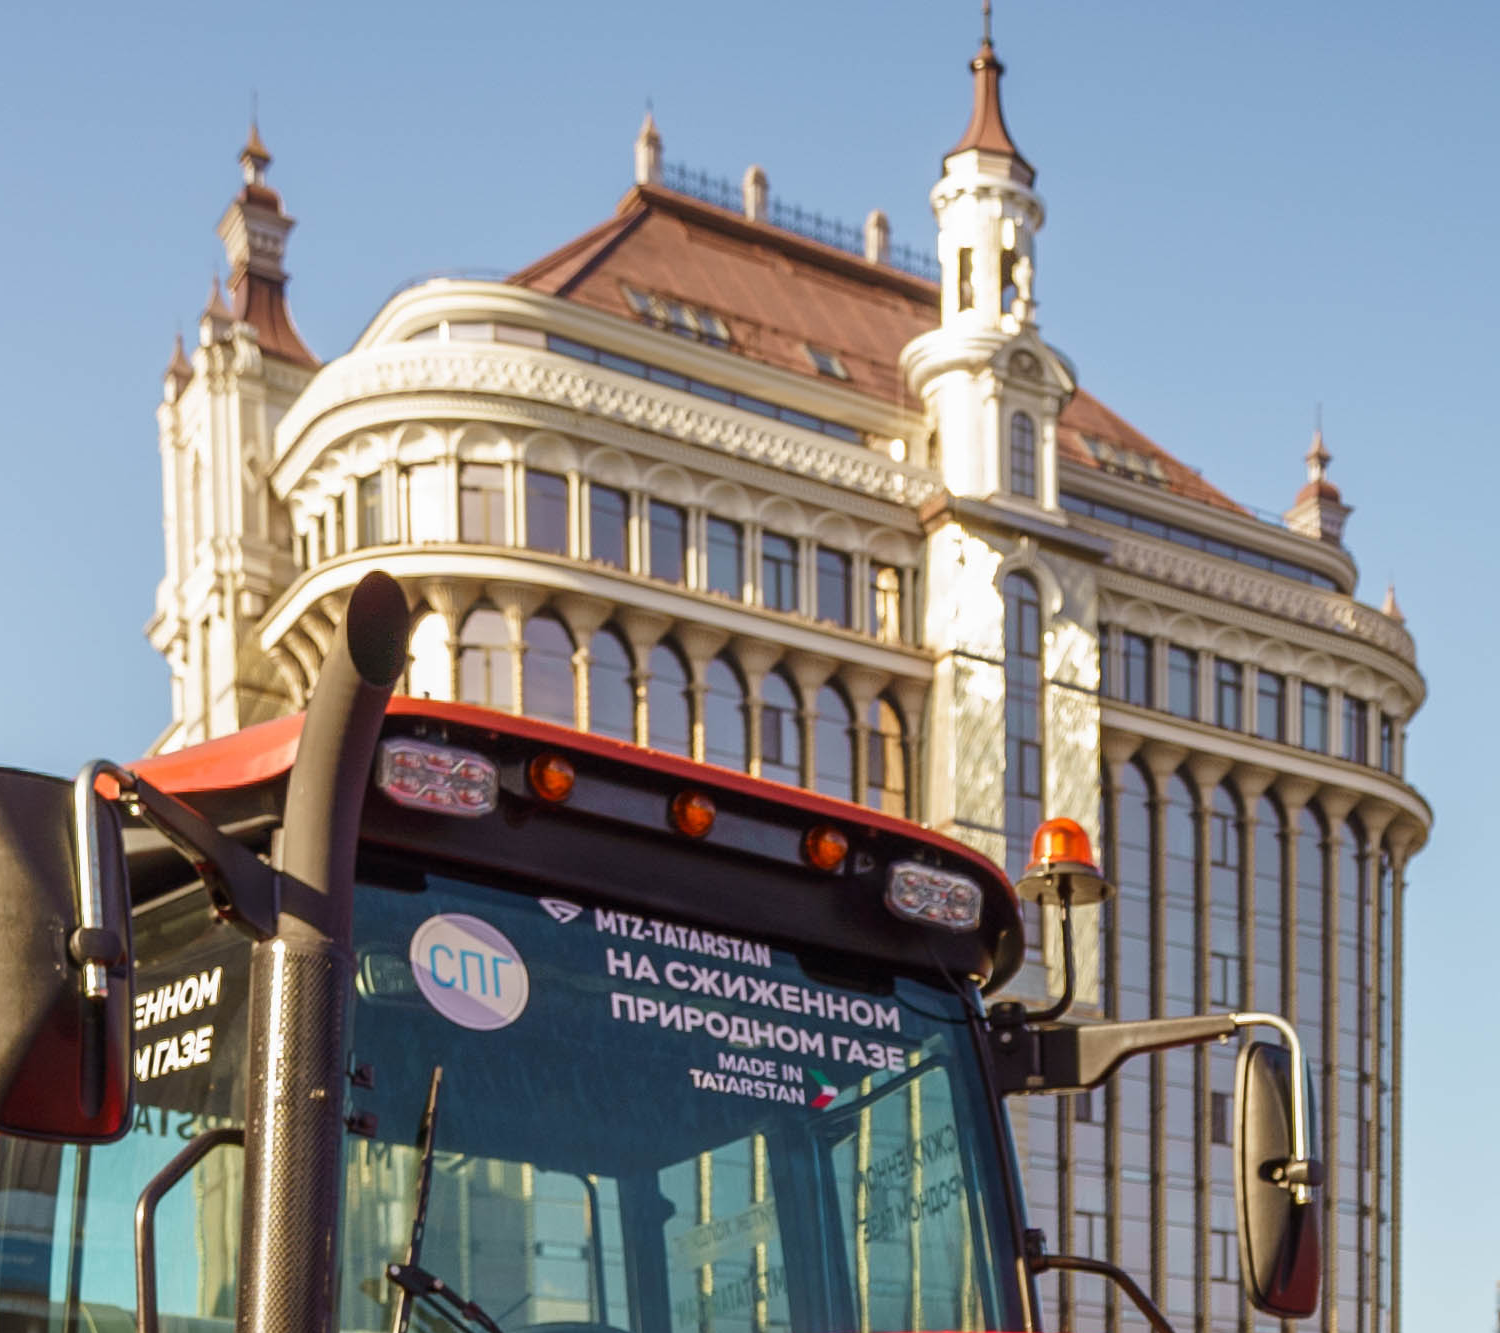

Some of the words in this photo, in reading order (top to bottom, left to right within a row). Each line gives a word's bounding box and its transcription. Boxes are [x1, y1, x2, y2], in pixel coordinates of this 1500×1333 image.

[594, 908, 771, 968] MTZ-TATARSTAN
[134, 965, 223, 1031] ЕННОМ
[429, 943, 513, 998] СПГ
[606, 947, 660, 985] НА
[664, 960, 900, 1033] СЖИЖЕННОМ
[150, 1024, 214, 1079] ГАЗЕ
[611, 991, 825, 1058] ПРИРОДНОМ
[831, 1036, 906, 1073] ГАЗЕ
[688, 1068, 806, 1105] TATARSTAN
[717, 1052, 778, 1080] MADE
[781, 1063, 803, 1083] IN
